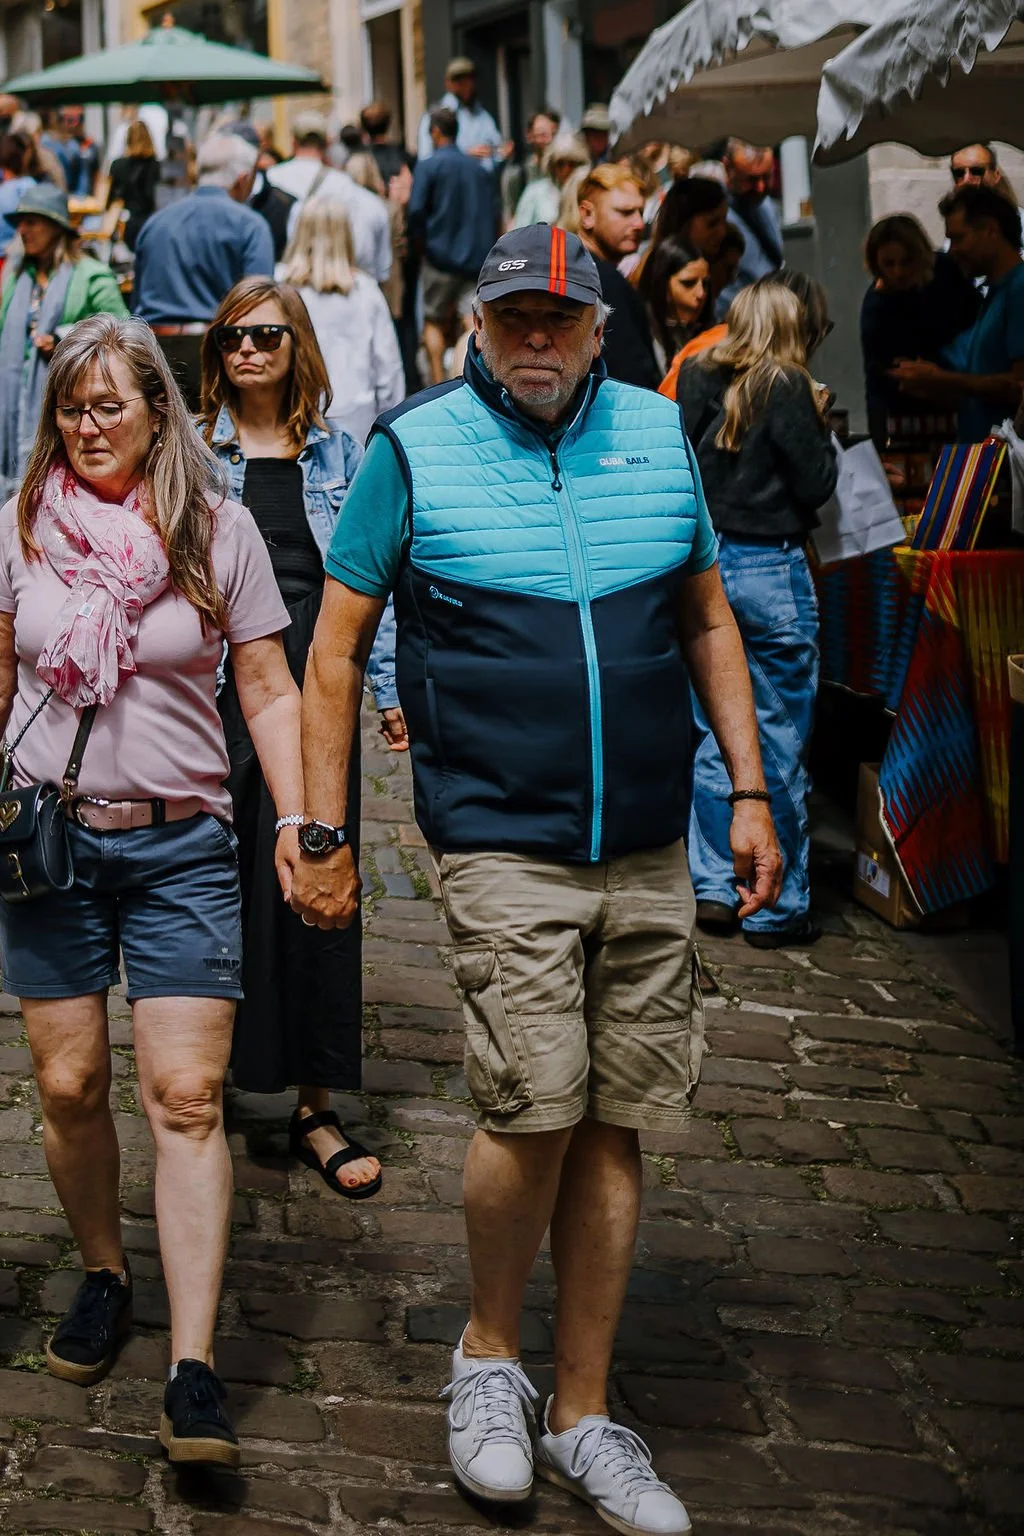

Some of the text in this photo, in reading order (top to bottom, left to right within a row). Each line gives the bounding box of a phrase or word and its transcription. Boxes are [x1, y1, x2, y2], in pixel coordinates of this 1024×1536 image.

[497, 259, 548, 272] GS
[599, 456, 650, 467] QUBA SAILS
